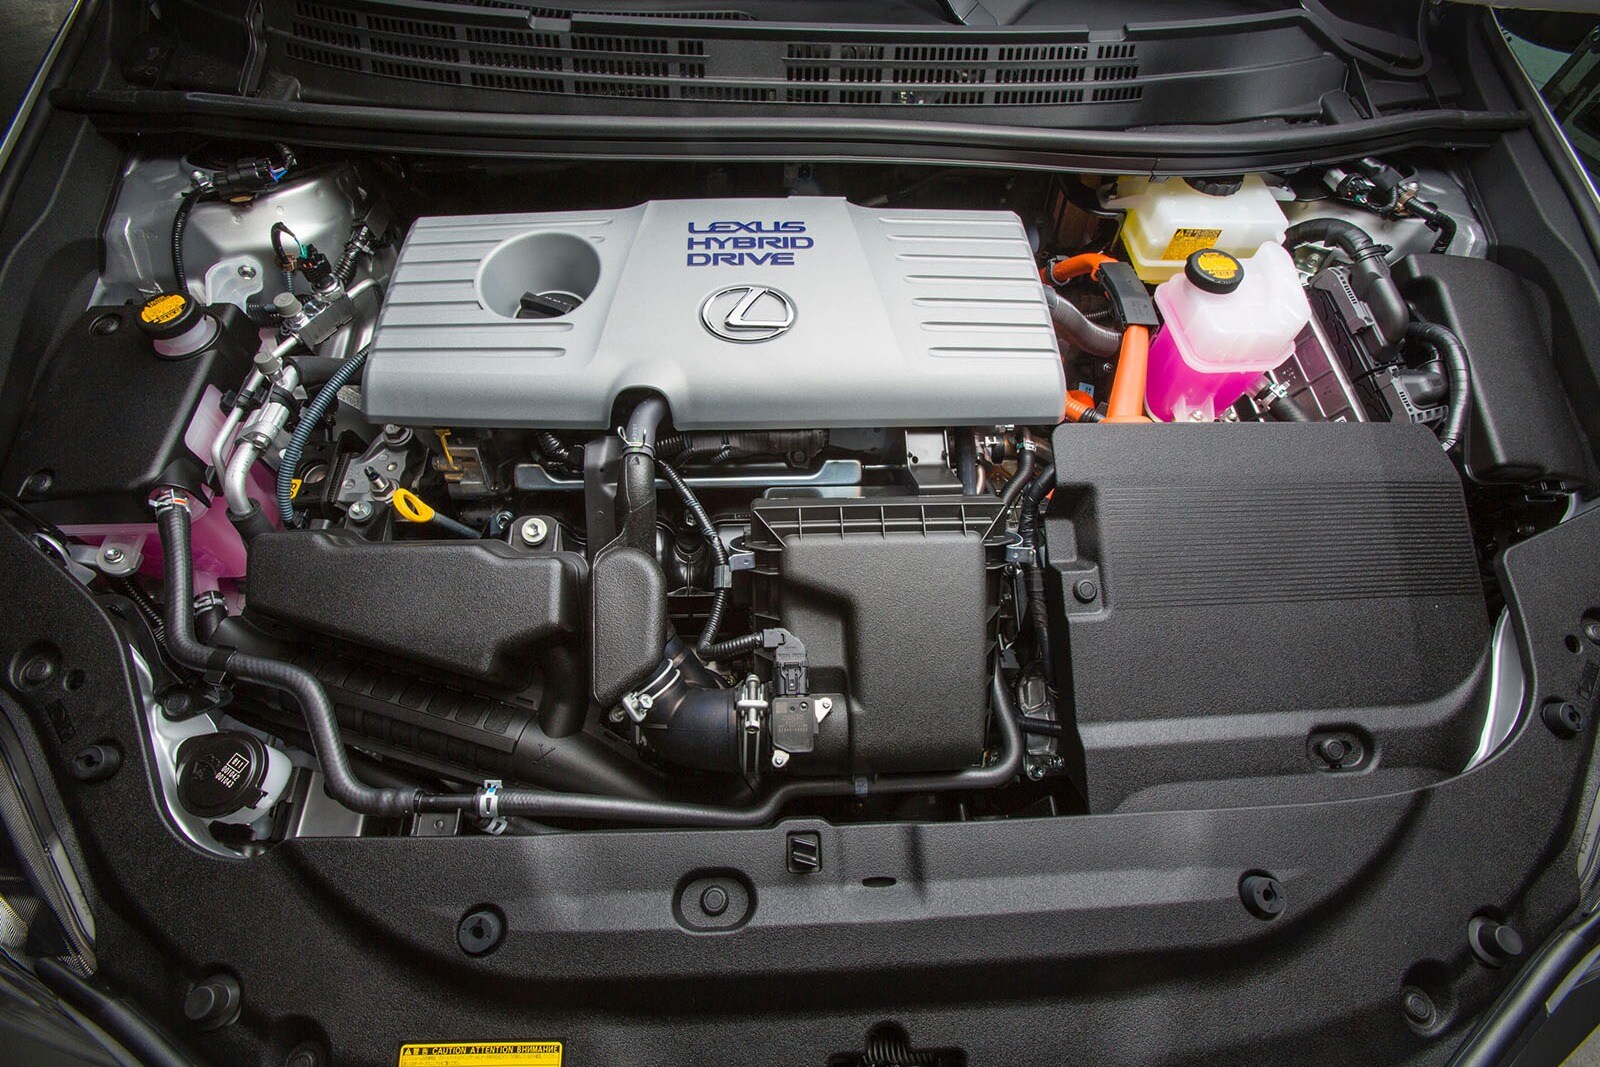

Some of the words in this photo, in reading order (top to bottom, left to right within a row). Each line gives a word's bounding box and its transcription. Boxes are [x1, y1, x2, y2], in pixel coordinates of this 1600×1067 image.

[687, 221, 806, 234] LEXUS
[687, 236, 814, 250] HYBRID
[687, 252, 795, 266] DRIVE
[432, 1047, 467, 1055] CAUTION
[469, 1046, 513, 1054] ATTENTION
[516, 1045, 560, 1053] ВНИМАНИЕ
